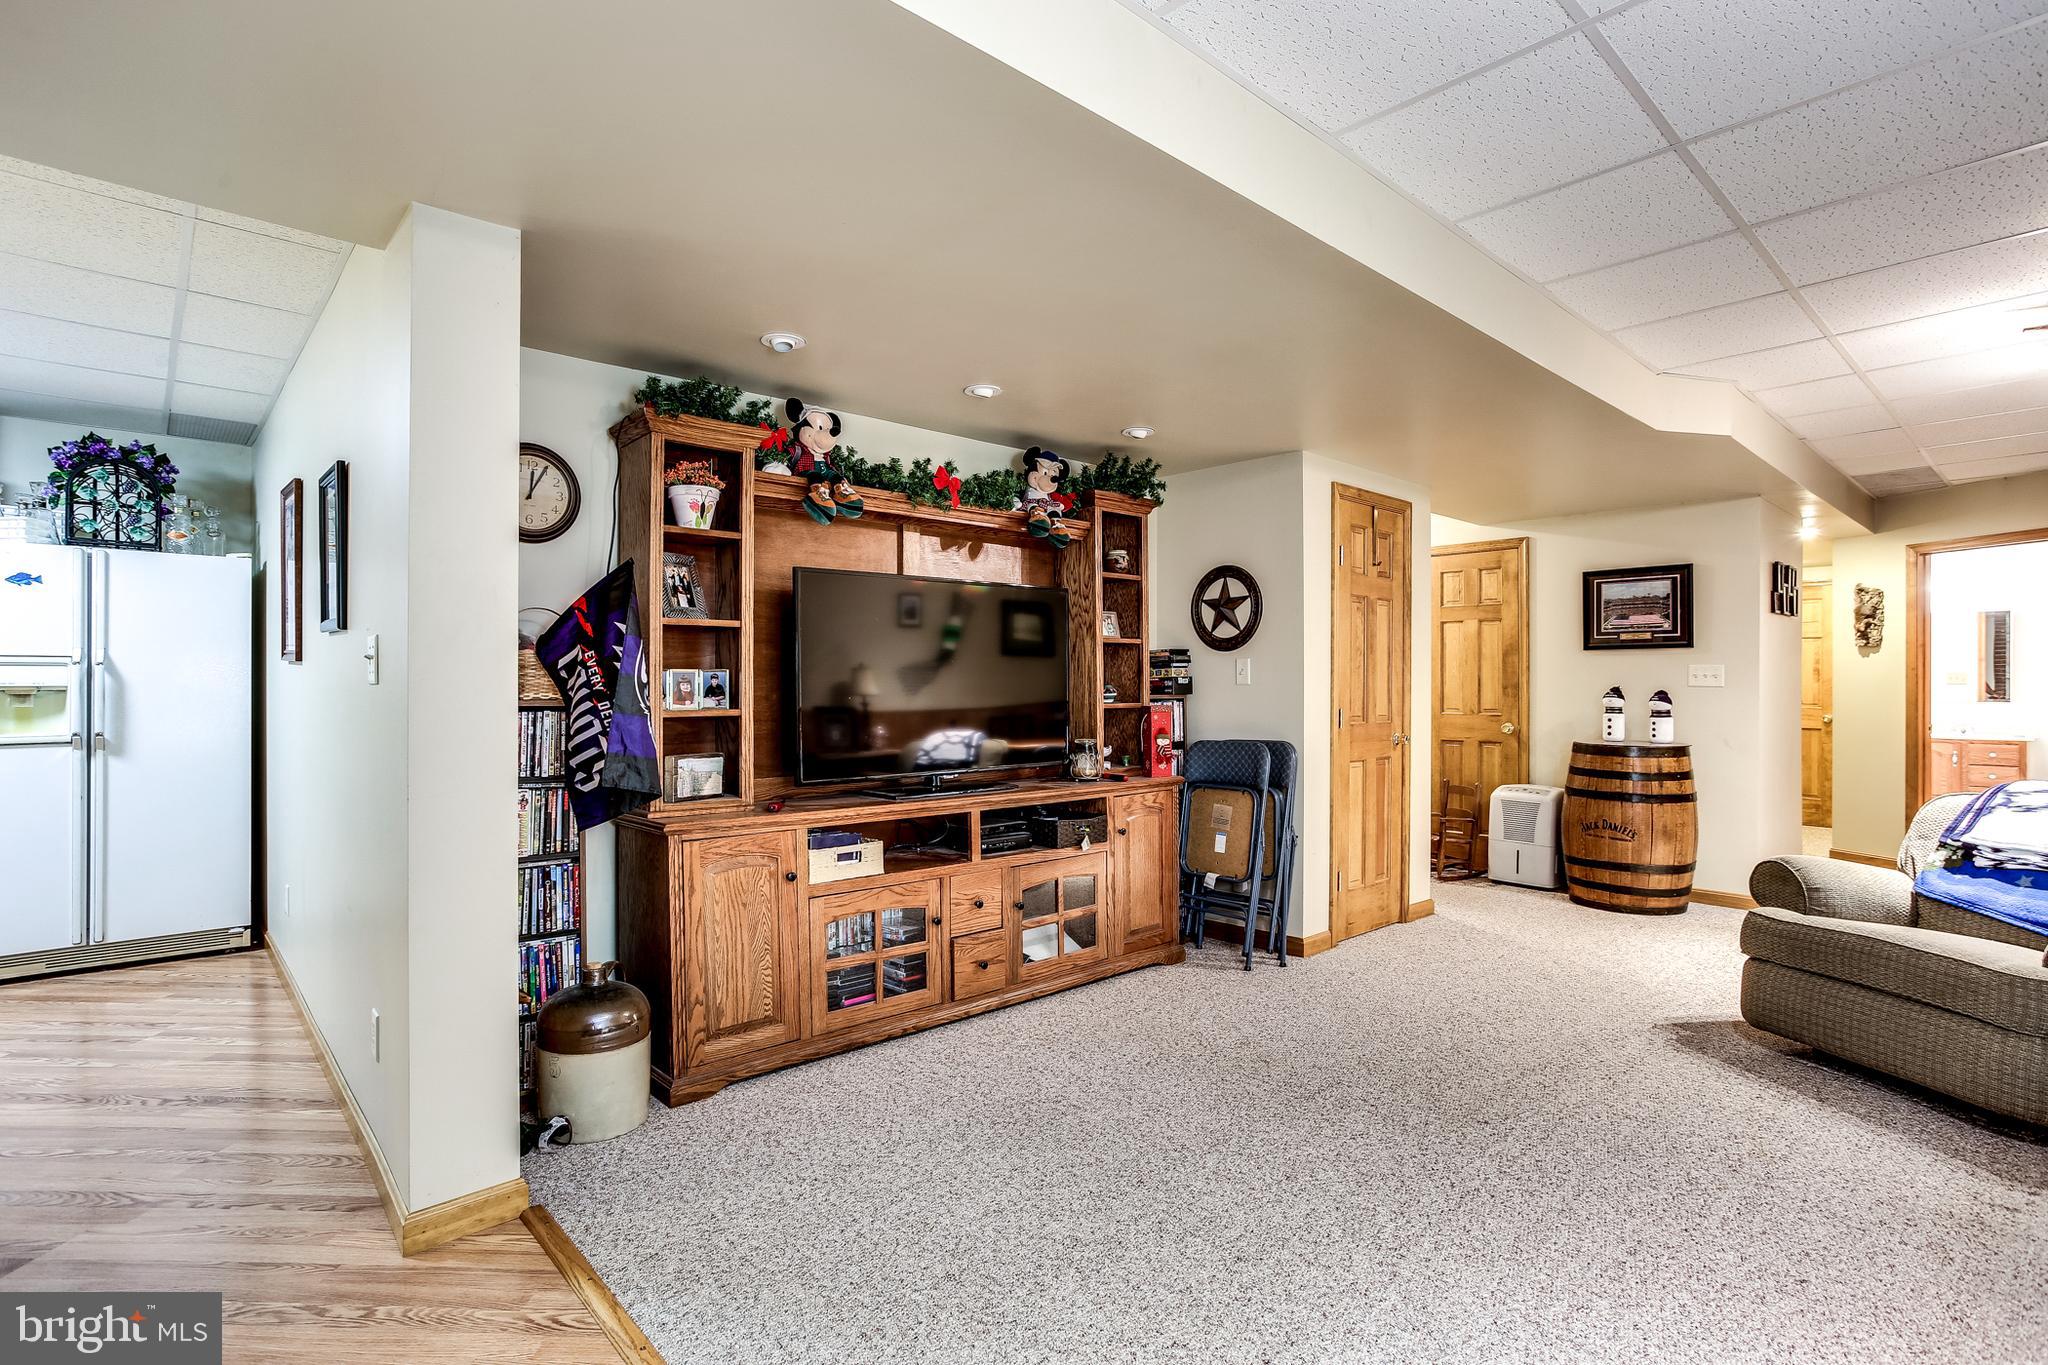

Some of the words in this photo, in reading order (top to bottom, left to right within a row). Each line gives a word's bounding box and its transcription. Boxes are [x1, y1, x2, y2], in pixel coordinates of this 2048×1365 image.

[527, 460, 539, 471] 12
[552, 477, 560, 488] 2
[555, 491, 564, 502] 3
[551, 505, 559, 514] 4
[525, 514, 534, 525] 6
[540, 512, 549, 523] 5
[584, 650, 604, 691] EVERY
